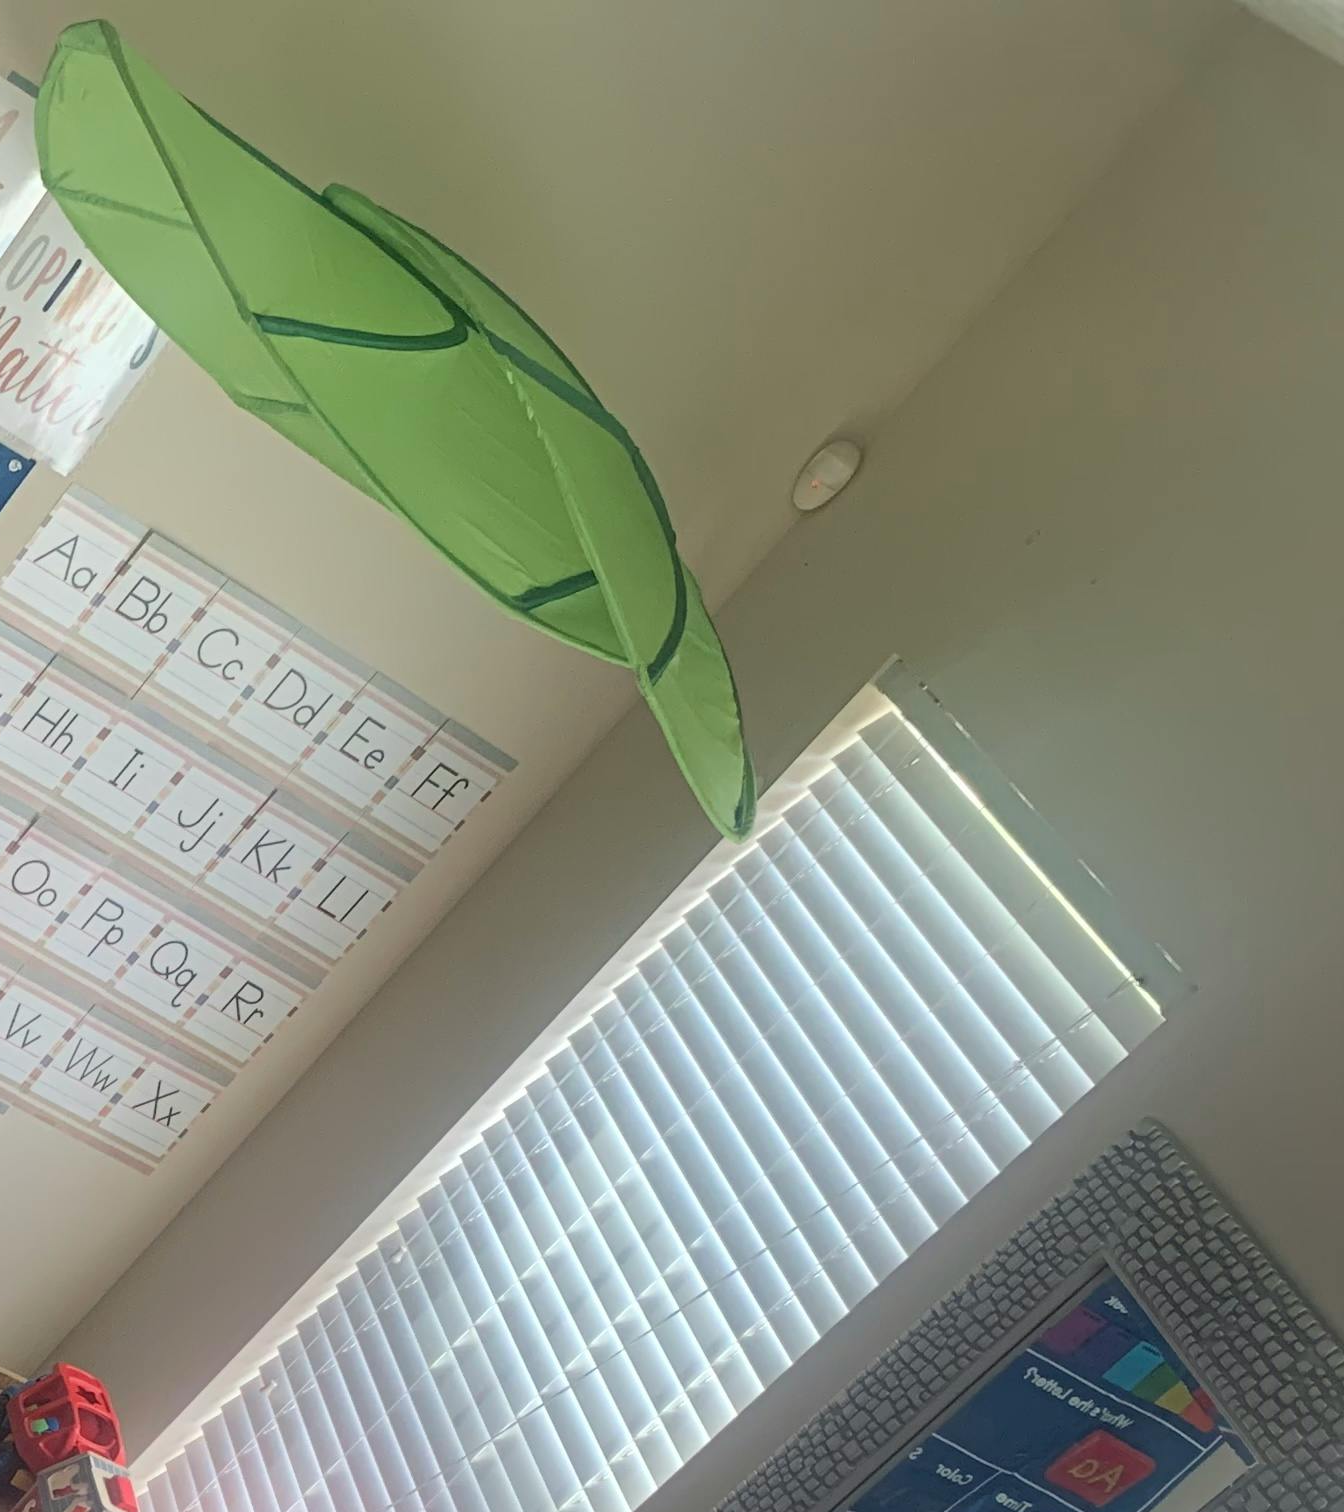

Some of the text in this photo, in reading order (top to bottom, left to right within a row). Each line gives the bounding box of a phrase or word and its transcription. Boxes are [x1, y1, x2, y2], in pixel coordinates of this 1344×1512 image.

[33, 534, 469, 811] Aa Bb Cc Dd Ee Ff
[21, 696, 80, 755] Hh
[107, 748, 146, 791] Ii
[176, 797, 224, 853] Jj
[240, 828, 296, 884] Kk
[316, 875, 370, 923] Ll
[11, 858, 58, 908] Oo
[80, 897, 125, 958] Pp
[149, 939, 198, 1008] Qq
[220, 980, 265, 1026] Rr
[5, 1002, 43, 1049] Vv
[64, 1037, 118, 1094] Ww
[132, 1079, 181, 1127] Xx
